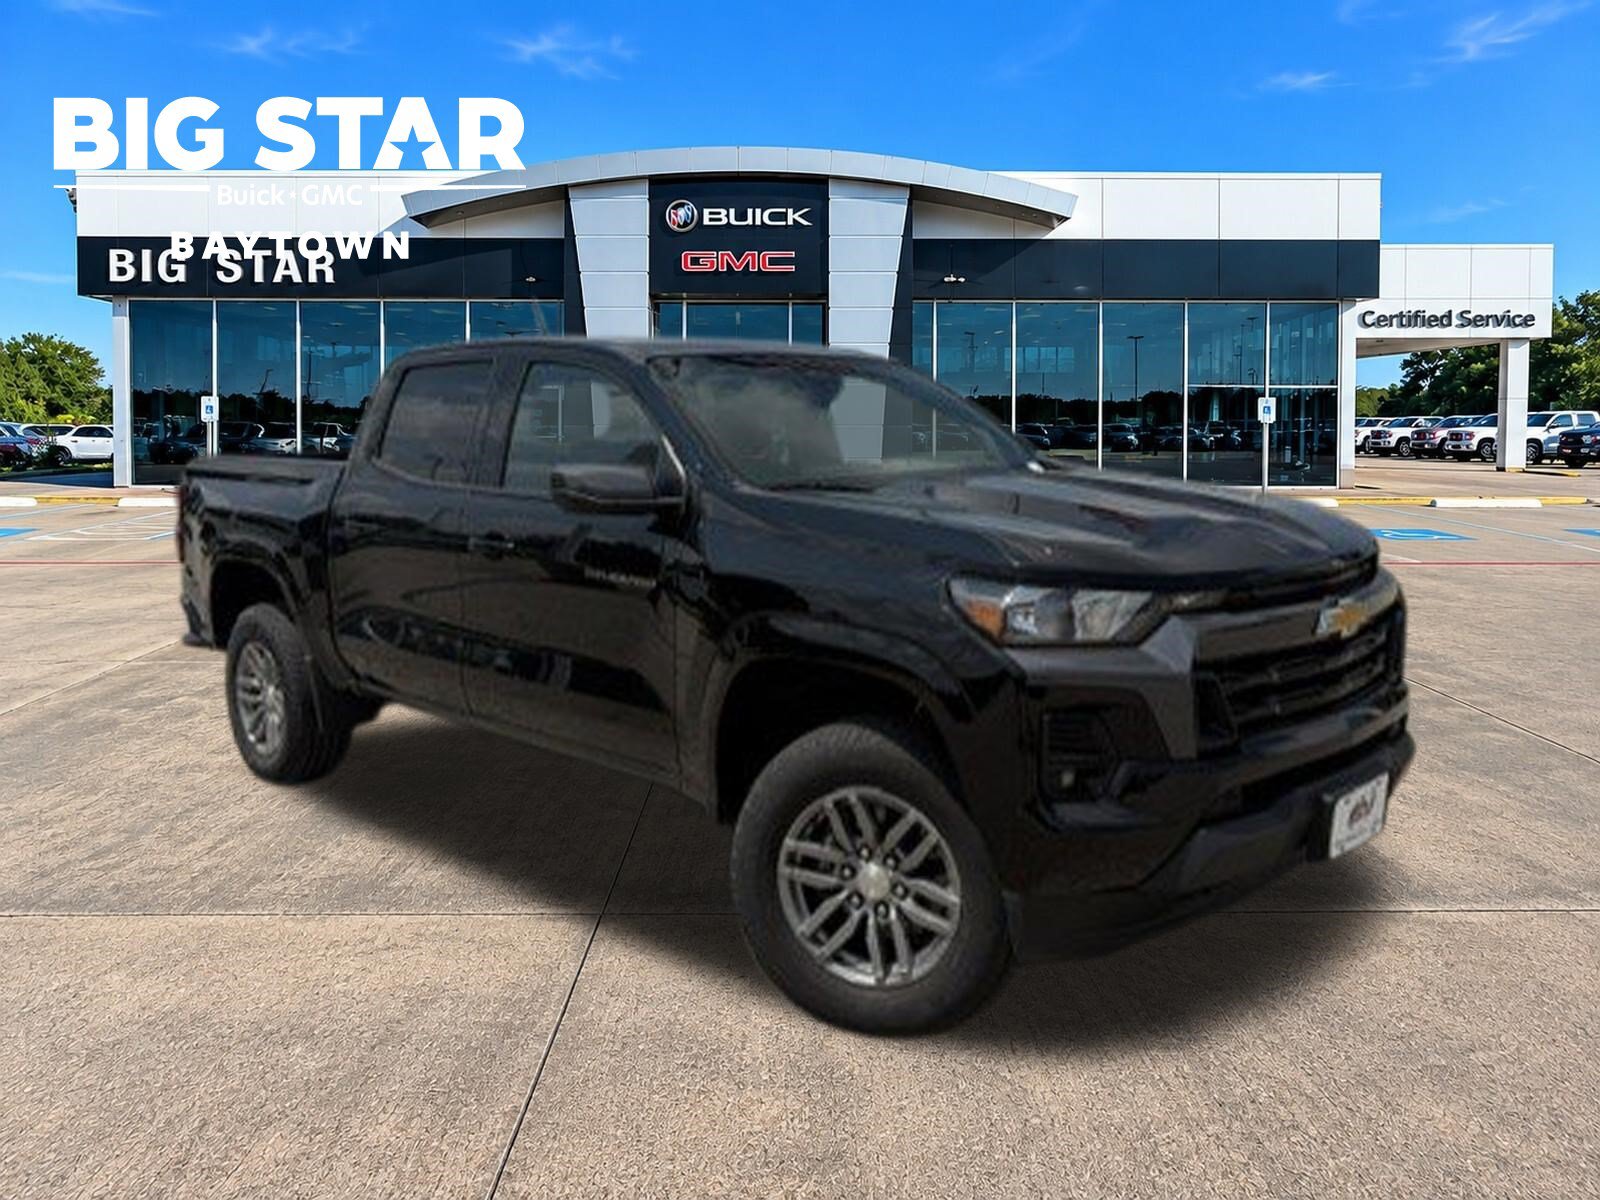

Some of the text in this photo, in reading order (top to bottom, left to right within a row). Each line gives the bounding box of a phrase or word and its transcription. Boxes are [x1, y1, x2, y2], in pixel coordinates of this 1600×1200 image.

[702, 207, 813, 226] BUICK
[108, 248, 336, 283] BIG STAR
[681, 251, 796, 272] GMC
[1359, 309, 1536, 328] Certified Service
